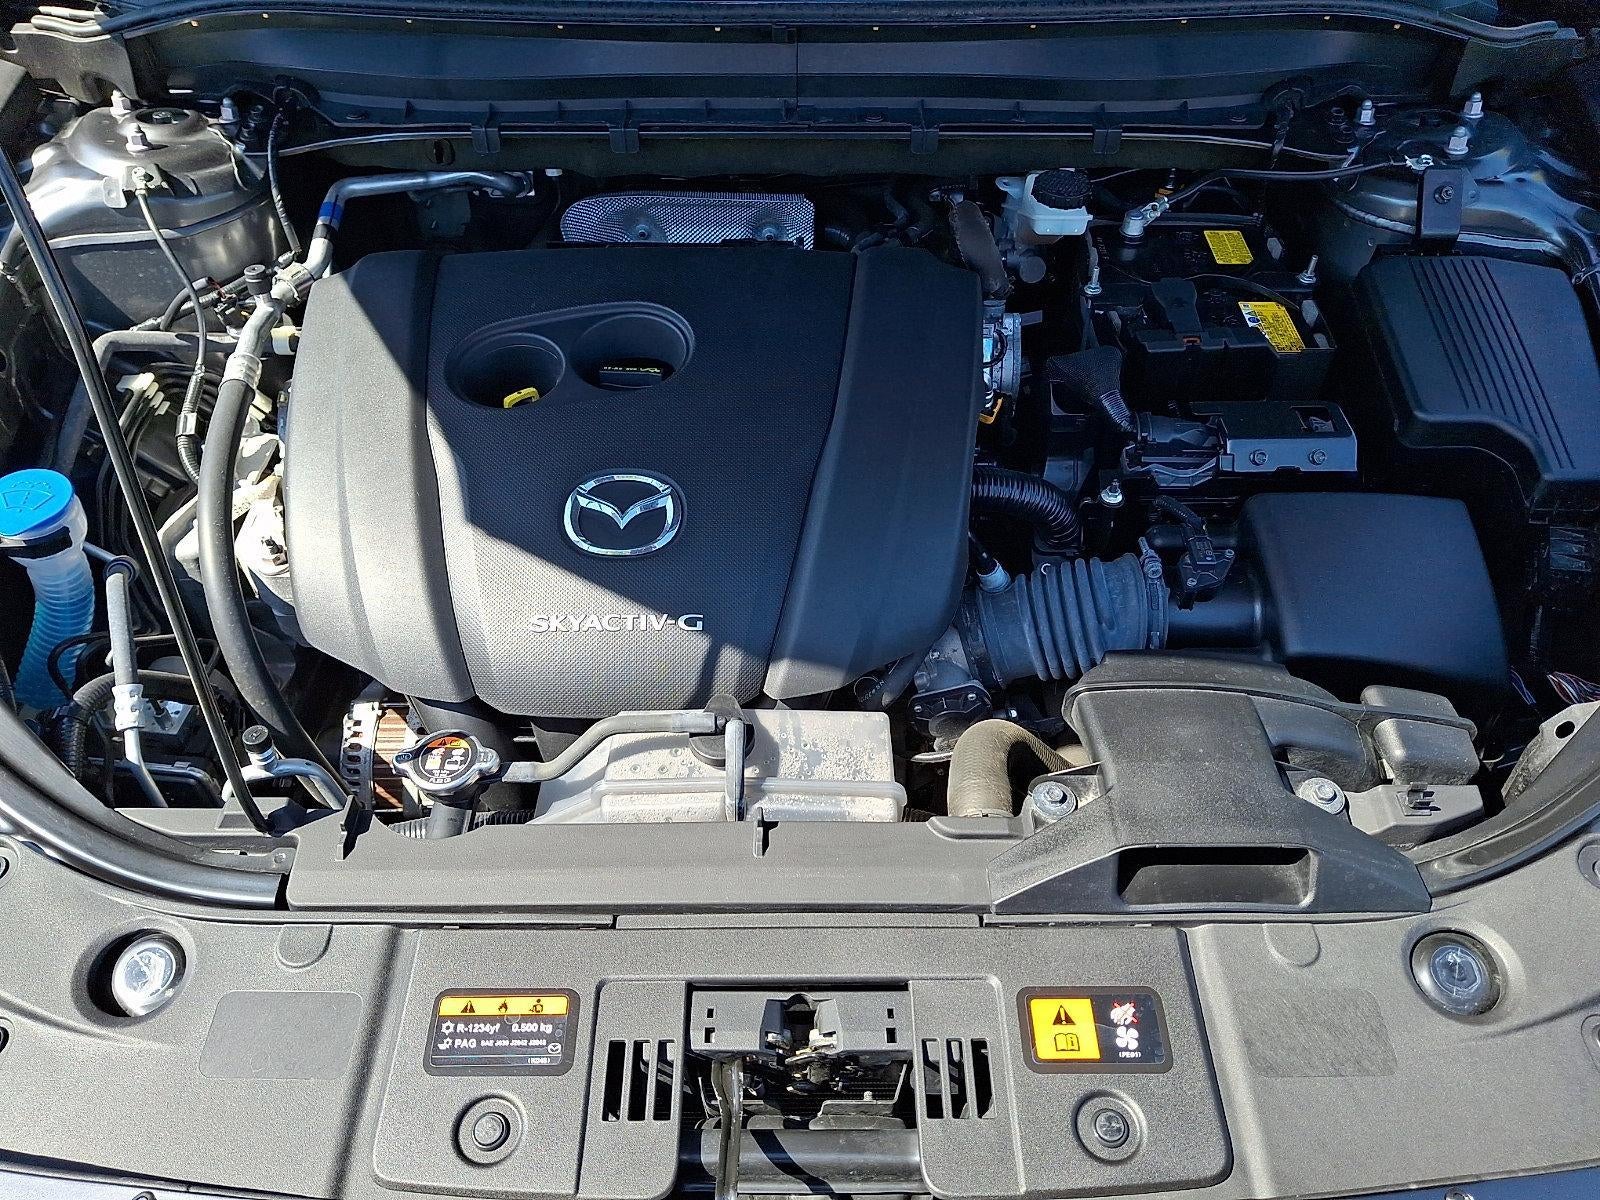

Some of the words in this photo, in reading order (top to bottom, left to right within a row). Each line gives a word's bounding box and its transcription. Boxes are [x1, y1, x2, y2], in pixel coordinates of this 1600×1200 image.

[530, 613, 704, 633] SKYACTIV-G
[456, 1022, 500, 1035] R-1234yf
[511, 1022, 538, 1033] 0.500
[540, 1022, 553, 1034] kg
[454, 1038, 477, 1049] PAG
